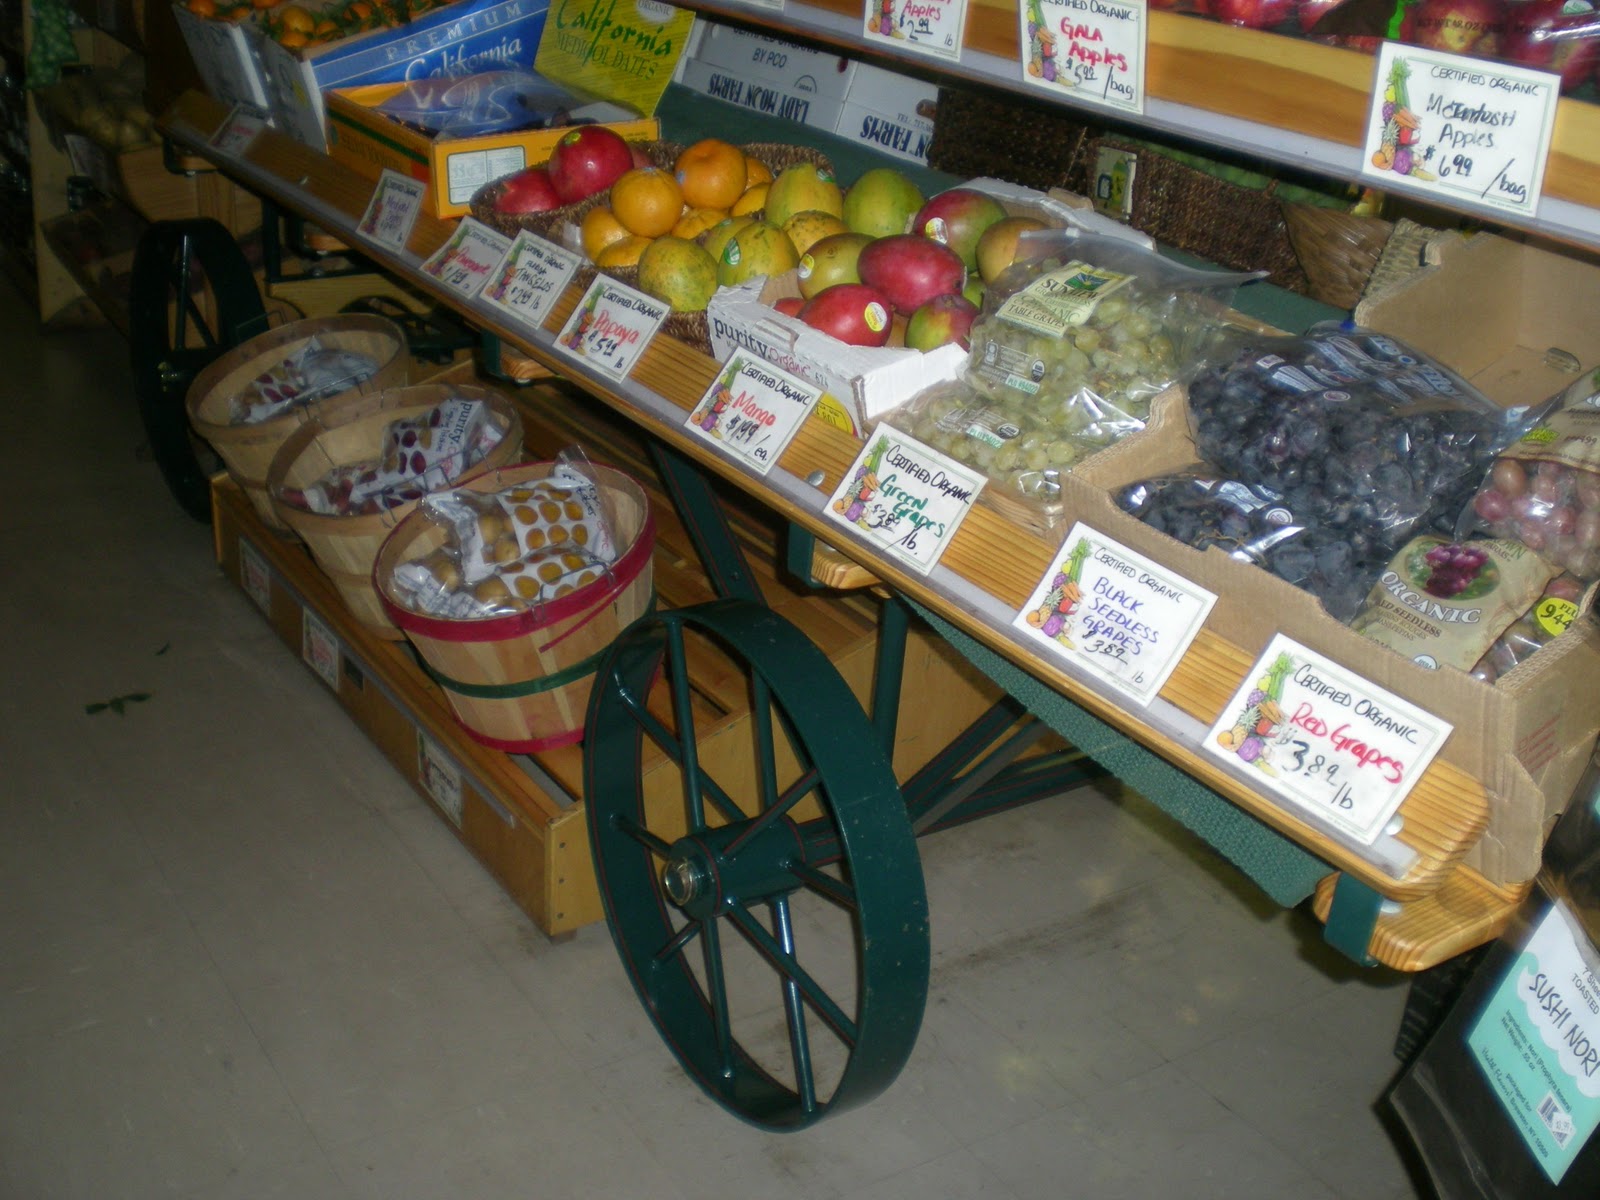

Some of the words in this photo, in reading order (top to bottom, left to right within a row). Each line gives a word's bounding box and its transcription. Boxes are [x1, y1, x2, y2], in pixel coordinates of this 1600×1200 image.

[902, 0, 941, 20] Apples
[1060, 16, 1103, 41] GALA
[1090, 0, 1135, 21] ORGANIC
[385, 2, 523, 61] PREMIUM
[556, 0, 673, 66] California
[405, 36, 523, 86] California
[611, 51, 659, 81] DATES
[752, 48, 767, 63] BY
[768, 51, 788, 69] PCO
[707, 73, 744, 103] FARMS
[1430, 65, 1486, 86] CERTIFIED
[1489, 77, 1540, 96] ORGANIC
[779, 92, 810, 124] LADY
[860, 115, 913, 153] FARMS
[1439, 123, 1495, 148] Apples
[602, 286, 632, 309] CERTIFIED
[631, 298, 664, 321] ORGANIC
[1033, 313, 1066, 329] GRAPES
[593, 309, 640, 347] Papaya
[741, 361, 776, 389] CERTIFIED
[774, 379, 811, 407] ORGANIC
[731, 390, 777, 428] Mango
[886, 445, 931, 484] CERTIFIED
[930, 471, 972, 505] ORGANIC
[892, 502, 945, 538] Grapes
[1094, 547, 1136, 578] CERTIFIED
[1138, 573, 1184, 604] ORGANIC
[1093, 576, 1144, 614] BLACK
[1380, 571, 1482, 625] ORGANIC
[1083, 615, 1144, 656] GRAPES
[1088, 597, 1160, 644] SEEDLESS
[1392, 604, 1442, 639] SEEDLESS
[1293, 664, 1352, 707] CERTIFIED
[1355, 699, 1418, 745] ORGANIC
[1330, 724, 1405, 785] Grapes
[1331, 781, 1353, 810] lb
[1571, 973, 1600, 1015] TOASTED
[1529, 973, 1572, 1029] SUSHI
[1563, 1024, 1600, 1079] NORI
